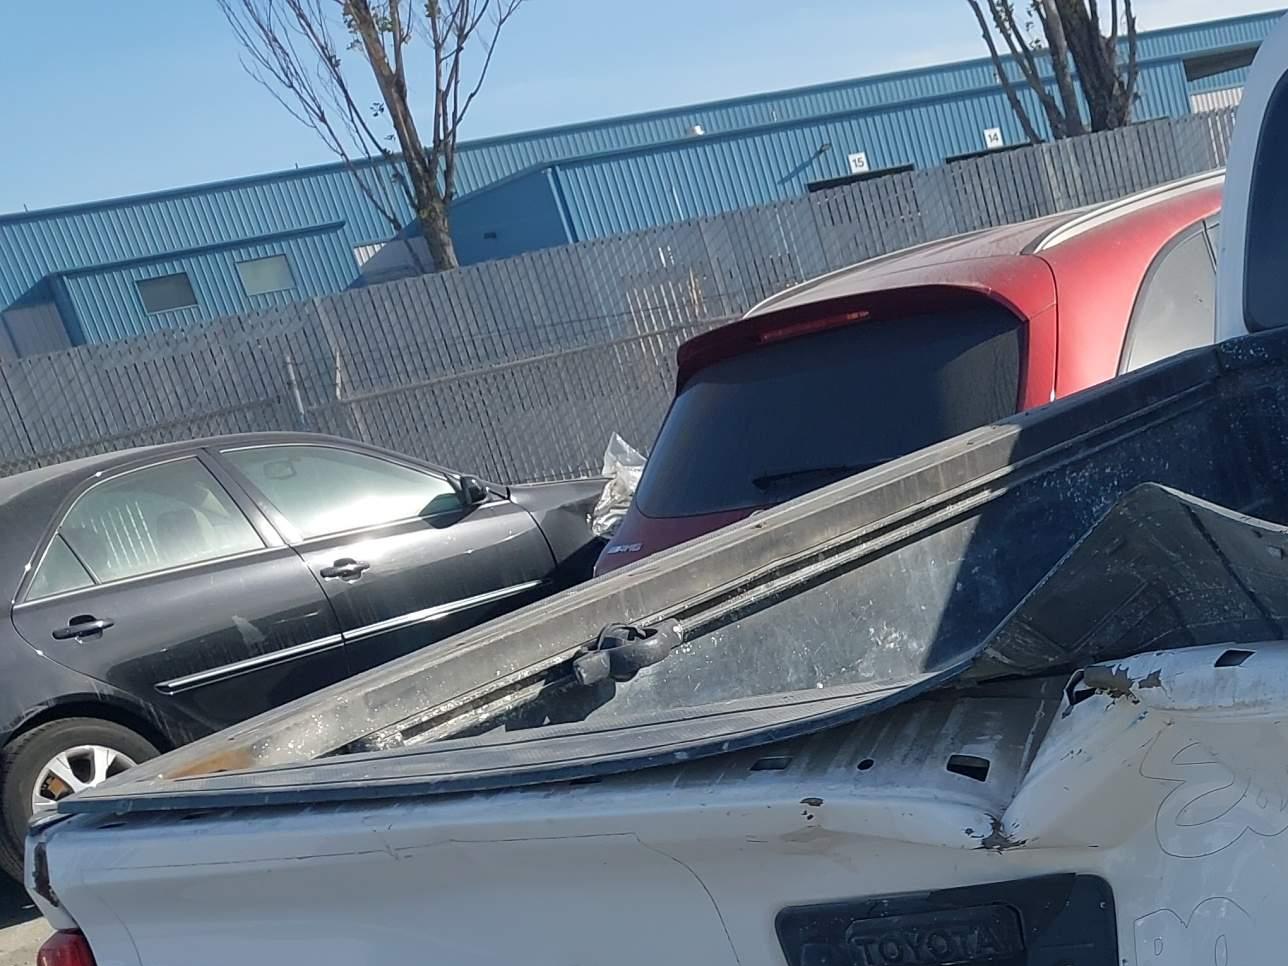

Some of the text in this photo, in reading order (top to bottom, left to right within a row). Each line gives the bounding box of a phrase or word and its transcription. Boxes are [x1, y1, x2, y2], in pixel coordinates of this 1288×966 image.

[988, 133, 999, 143] 14
[852, 157, 866, 168] 15
[851, 924, 1005, 966] TOYOTA
